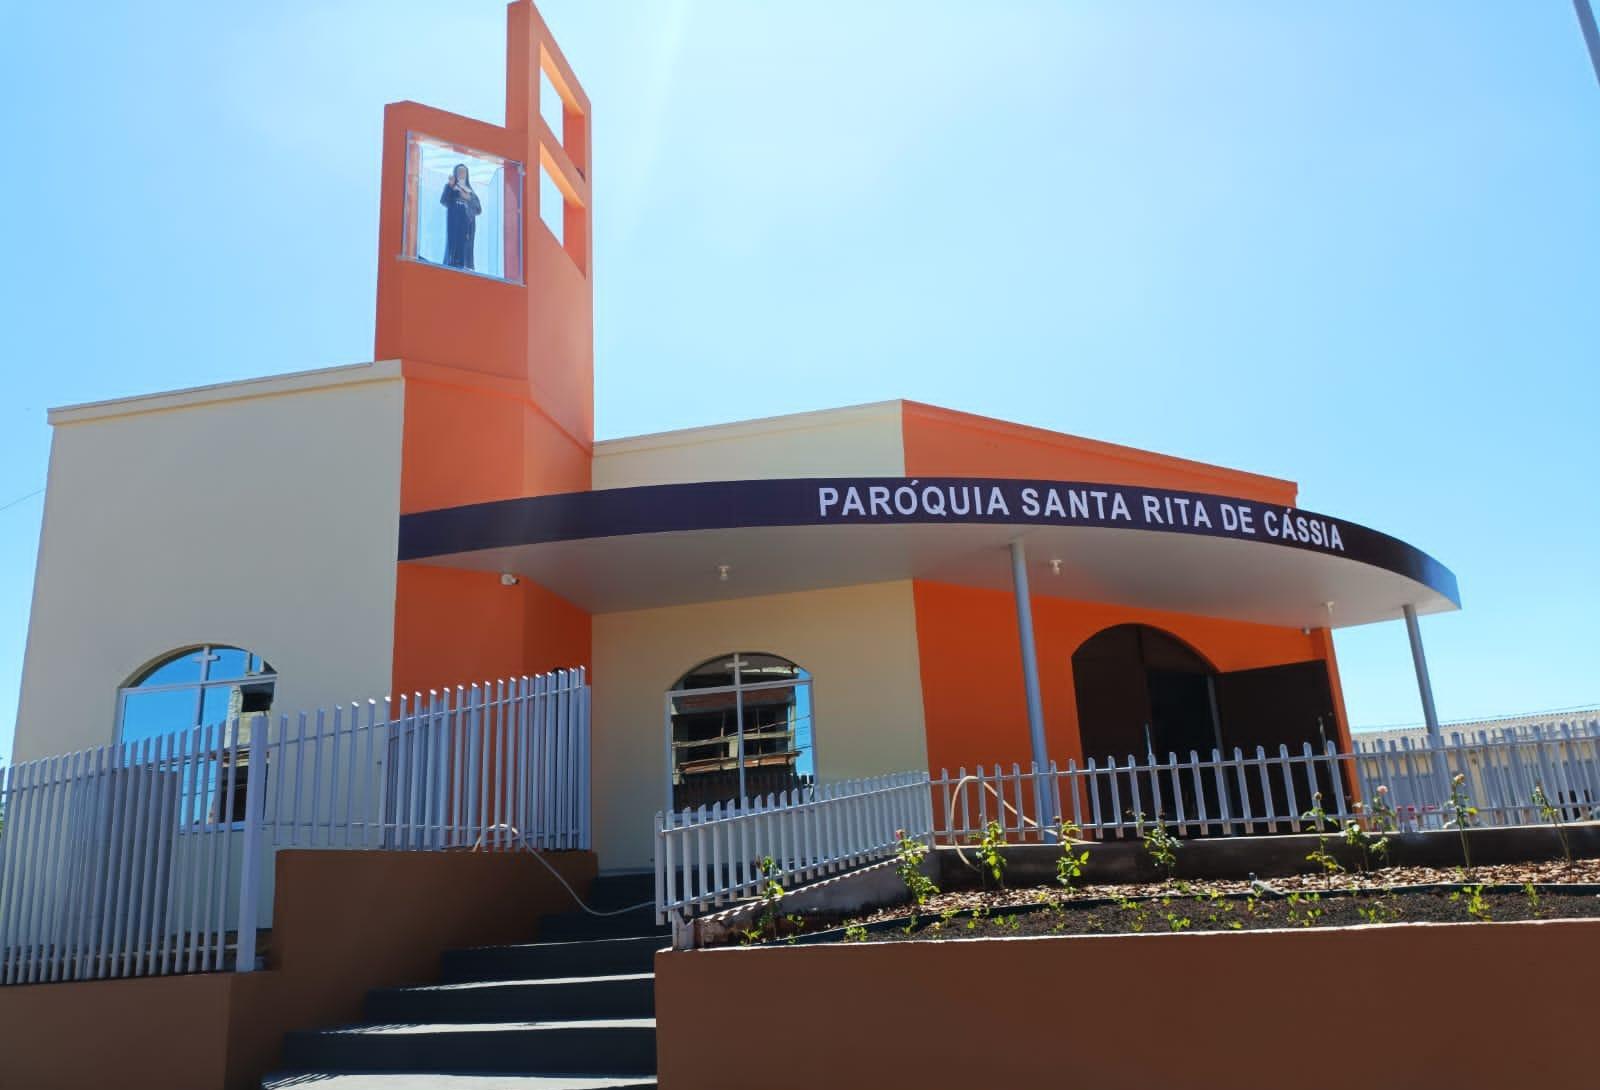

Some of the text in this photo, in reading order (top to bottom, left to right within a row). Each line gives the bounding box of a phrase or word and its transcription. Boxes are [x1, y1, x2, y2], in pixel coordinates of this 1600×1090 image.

[818, 479, 1345, 551] PARÓQUIA SANTA RITA DE CÁSSIA
